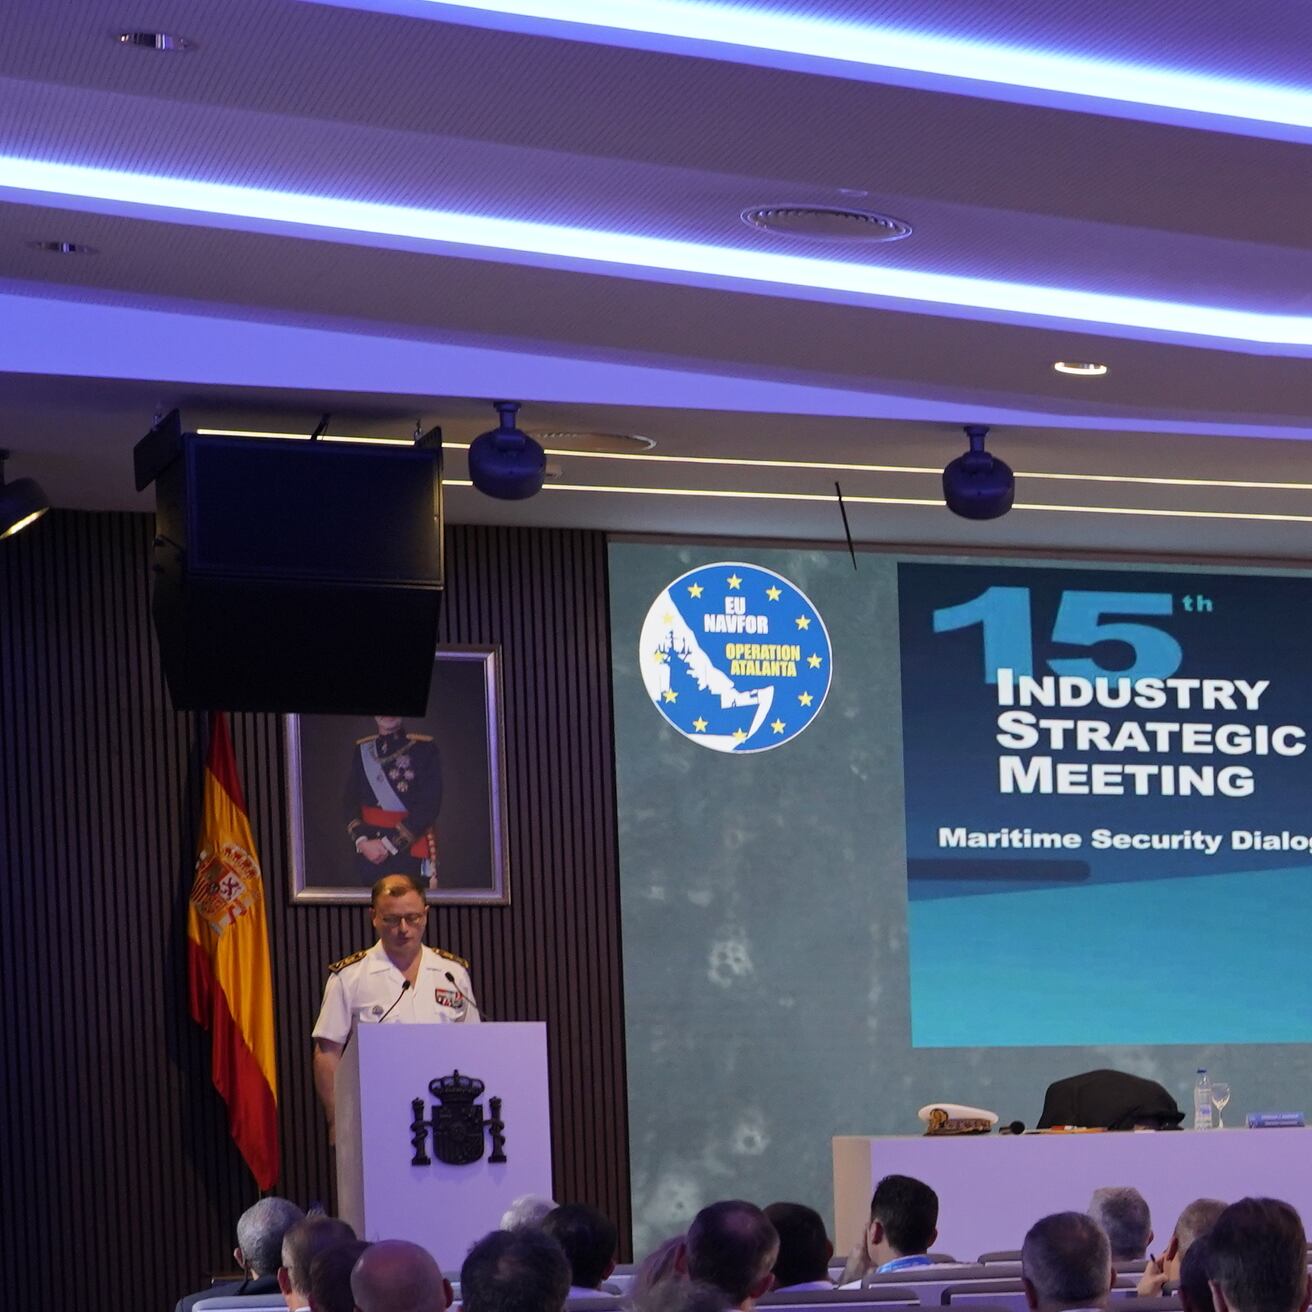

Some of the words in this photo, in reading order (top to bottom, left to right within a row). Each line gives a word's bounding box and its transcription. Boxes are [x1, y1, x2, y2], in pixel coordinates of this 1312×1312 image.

[725, 596, 746, 615] EU
[704, 614, 769, 634] NAVFOR
[726, 643, 800, 661] OPERATION
[731, 660, 797, 677] ATALANTA
[997, 668, 1270, 710] INDUSTRY
[996, 710, 1307, 756] STRATEGIC
[999, 755, 1255, 797] MEETING
[938, 827, 1082, 849] Maritime
[1091, 829, 1223, 855] Security
